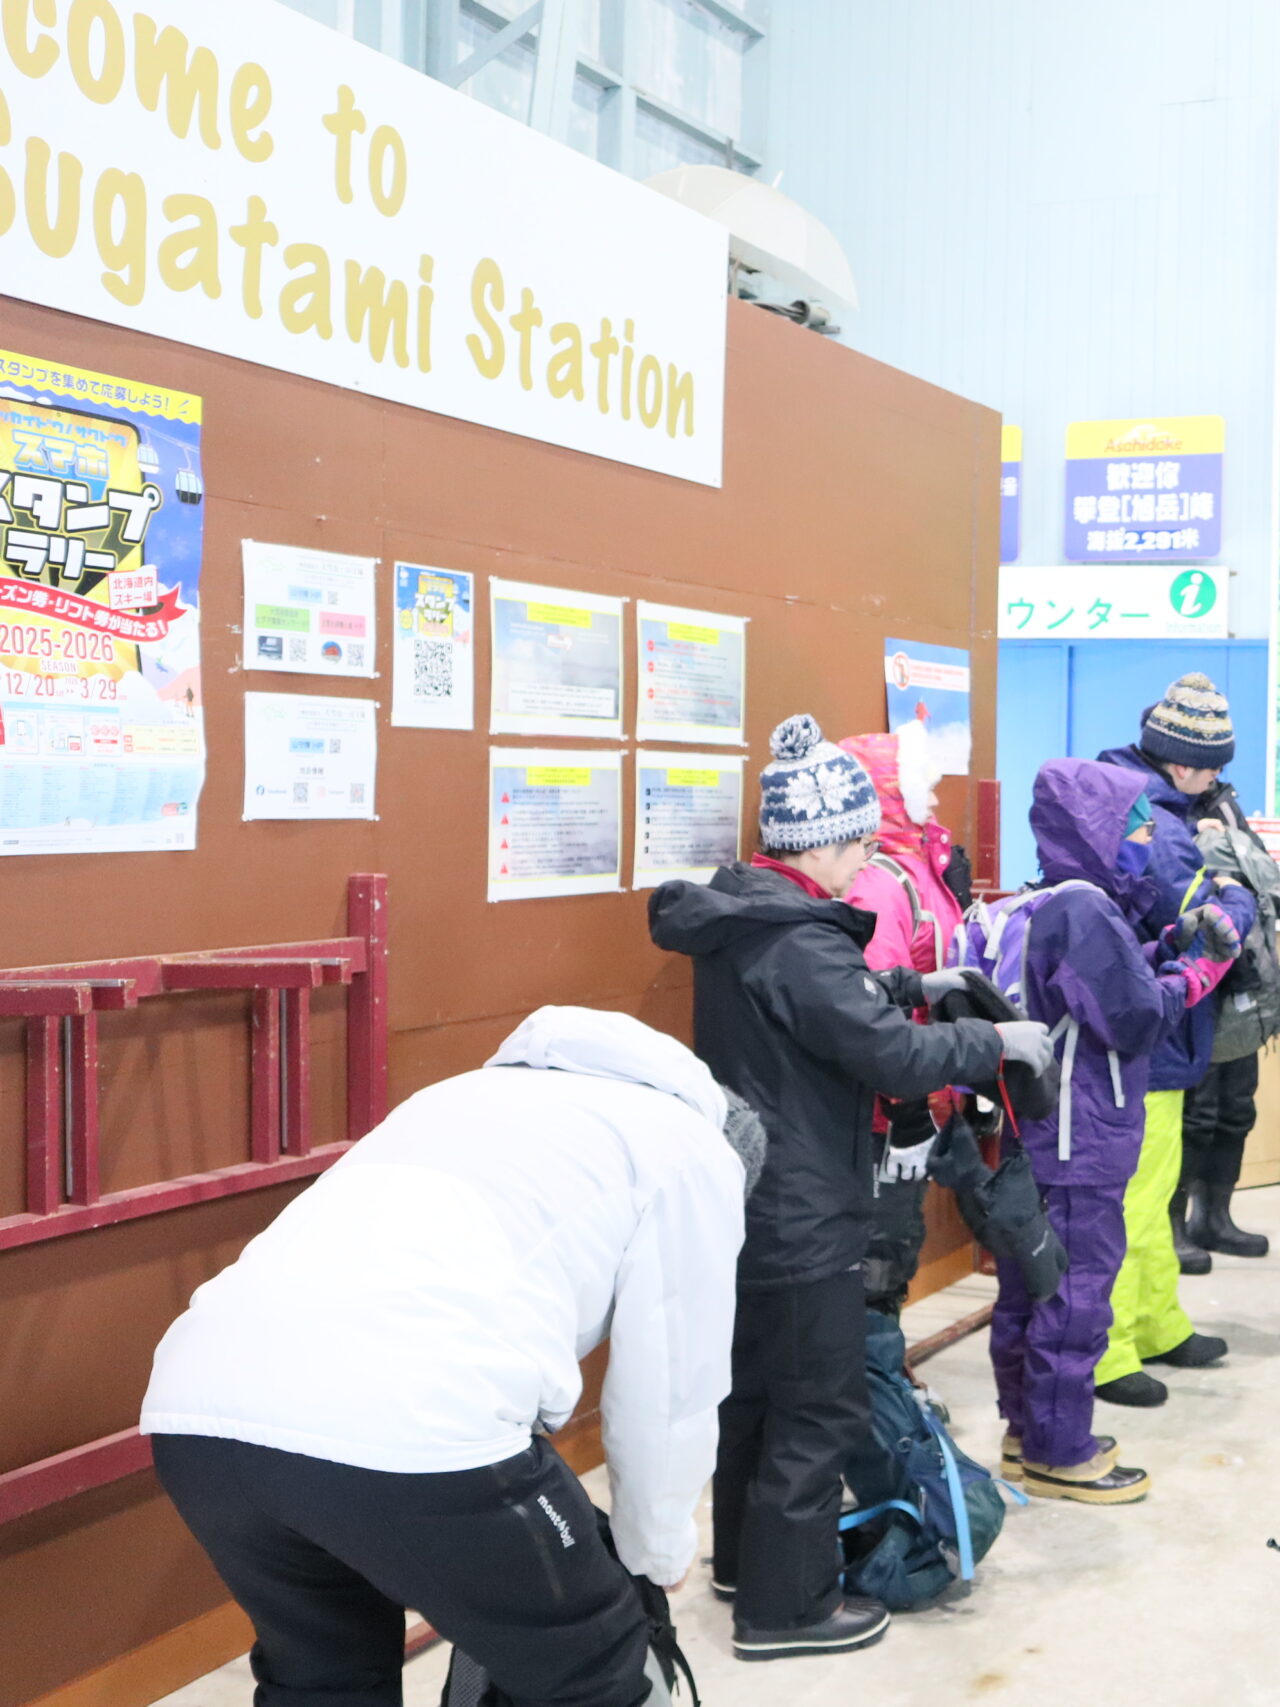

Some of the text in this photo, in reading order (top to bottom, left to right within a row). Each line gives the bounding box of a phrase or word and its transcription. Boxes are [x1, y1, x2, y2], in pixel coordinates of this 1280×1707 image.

[322, 84, 408, 218] to
[465, 257, 695, 439] Station
[1104, 437, 1183, 453] Asahidake
[5, 529, 117, 581] ラリー
[1007, 598, 1150, 630] ウンター
[0, 625, 114, 662] 2025-2026
